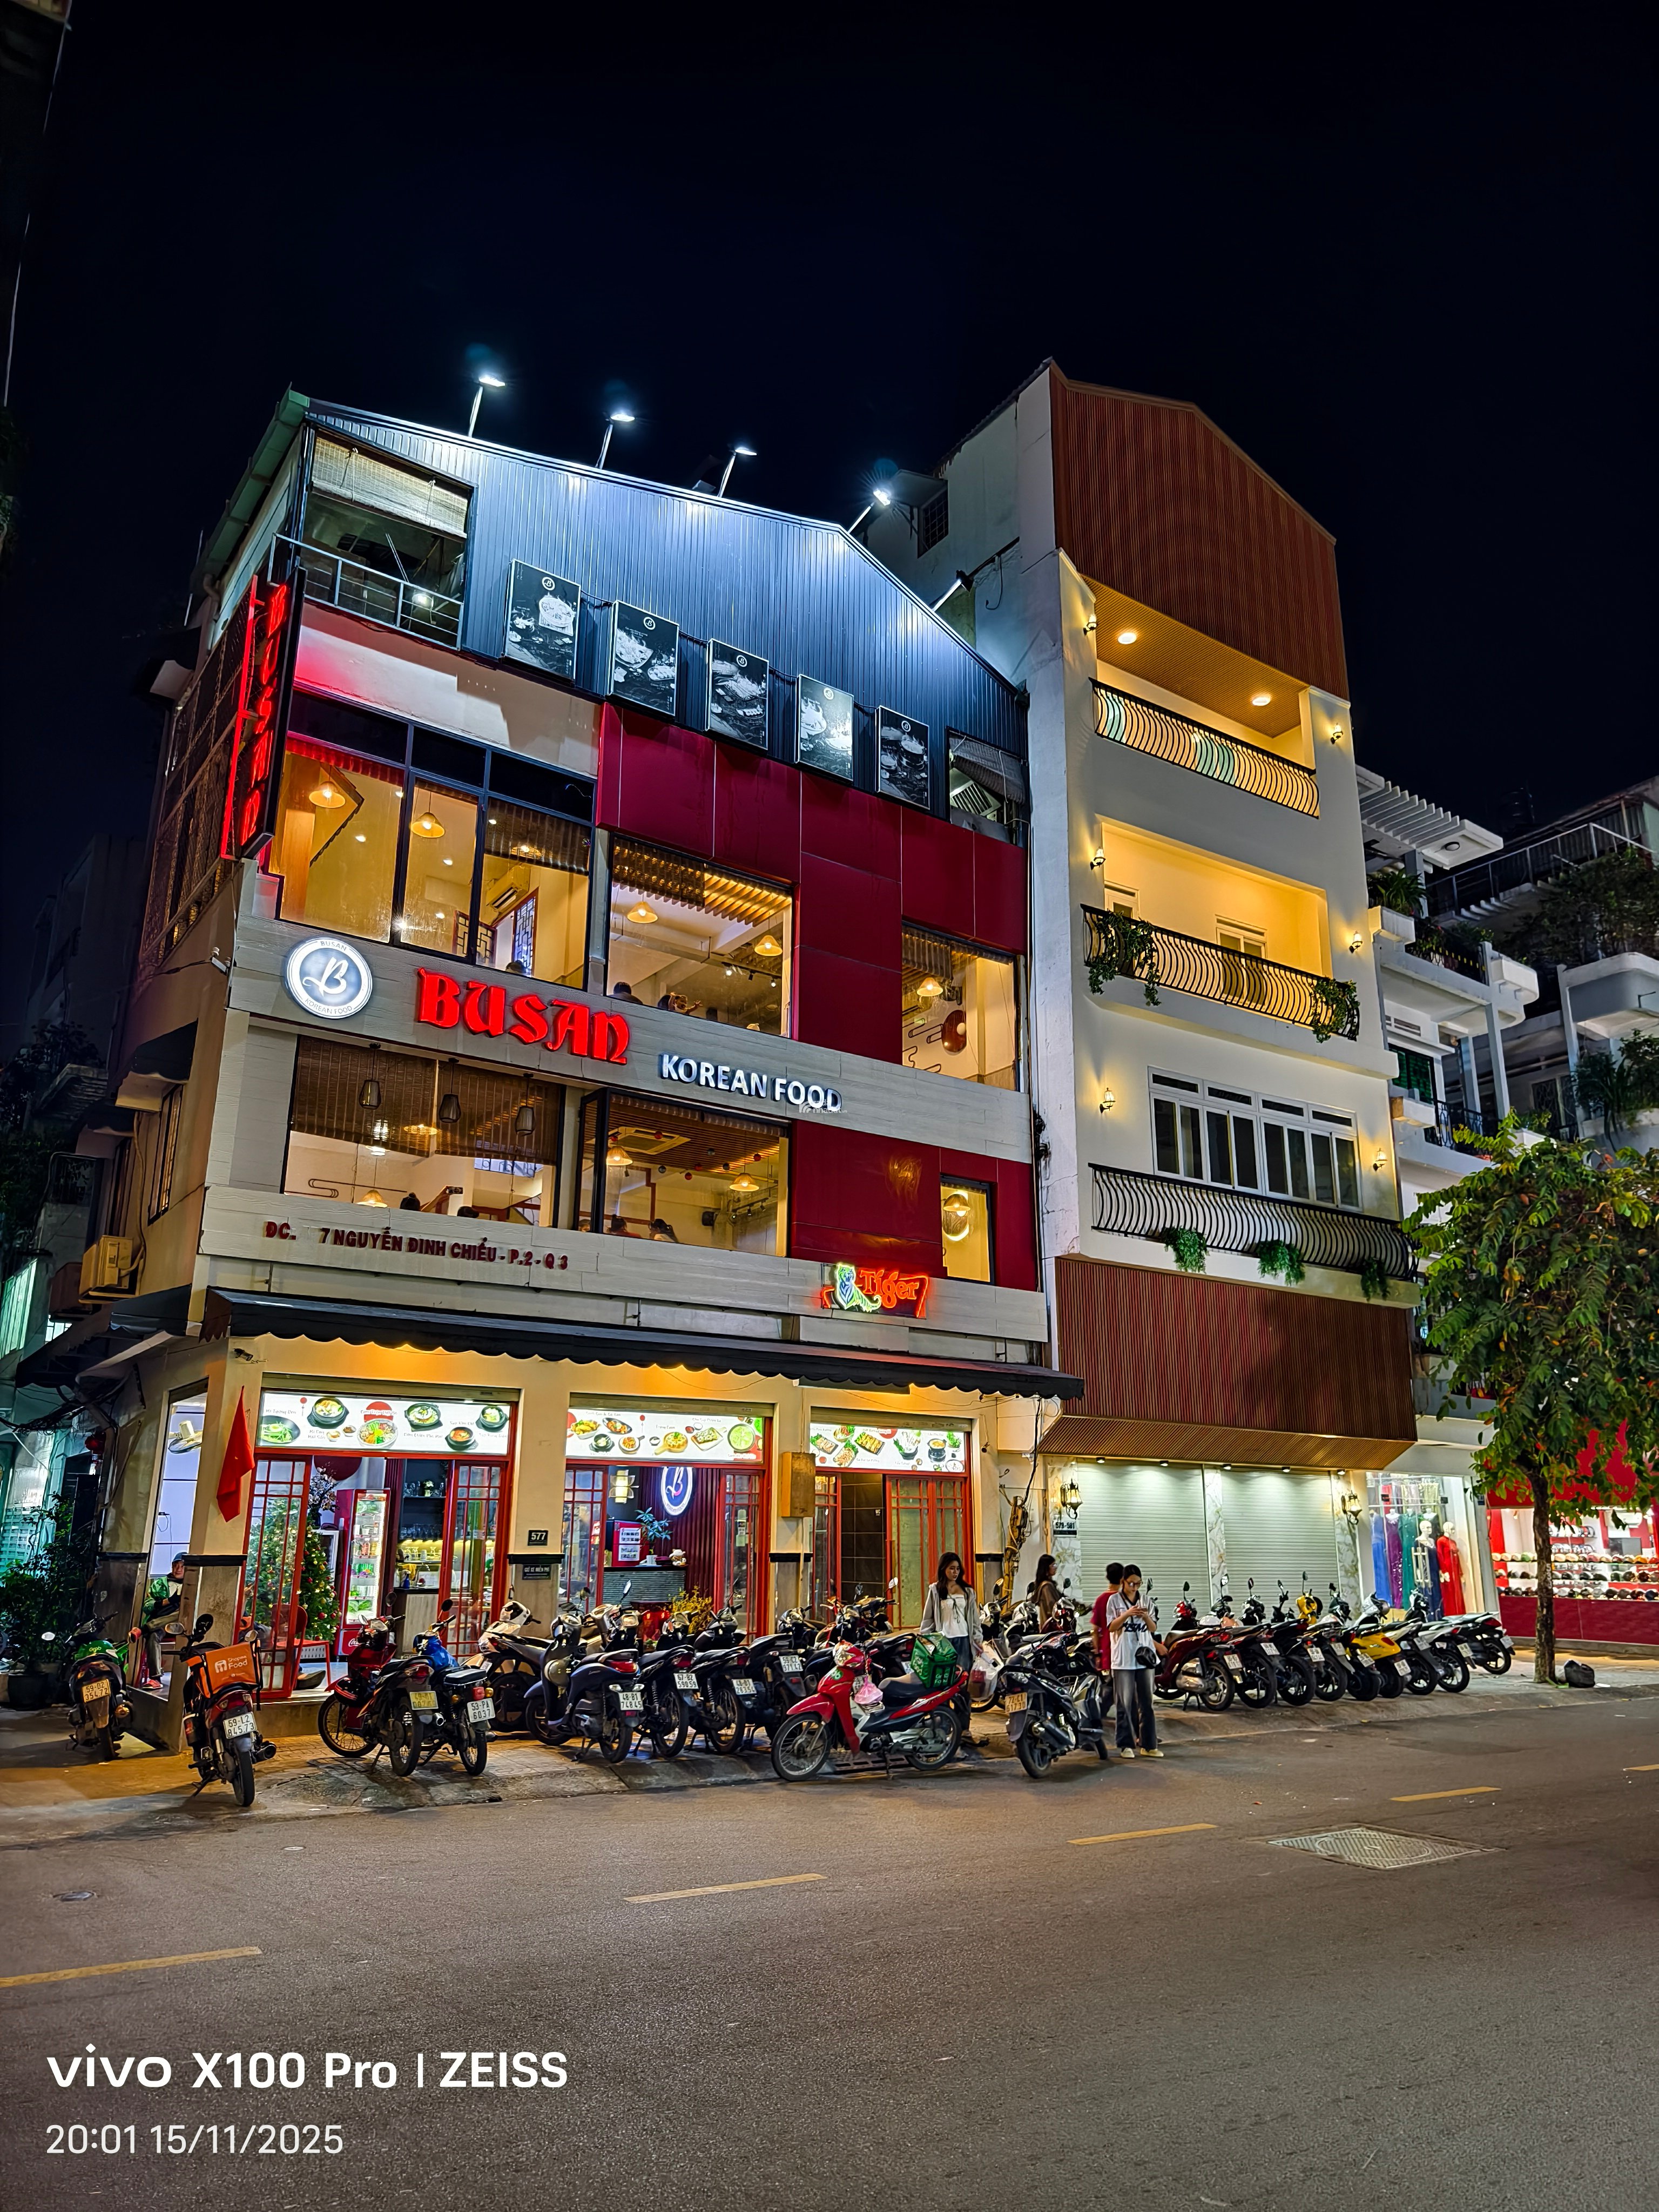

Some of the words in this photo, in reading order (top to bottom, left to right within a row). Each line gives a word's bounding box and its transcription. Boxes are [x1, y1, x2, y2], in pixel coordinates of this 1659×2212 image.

[320, 941, 347, 951] BUSAN
[305, 998, 332, 1014] KOREAN
[334, 1006, 353, 1014] FOOD
[417, 967, 630, 1065] BUSAN
[661, 1054, 767, 1098] KOREAN
[774, 1077, 842, 1111] FOOD
[860, 1269, 919, 1309] Tiger
[531, 1532, 547, 1540] 577
[228, 1660, 248, 1670] Food
[471, 1700, 490, 1711] 53-PA
[473, 1709, 491, 1720] 6037
[228, 1715, 251, 1728] 59-L2
[227, 1722, 255, 1737] 845.73
